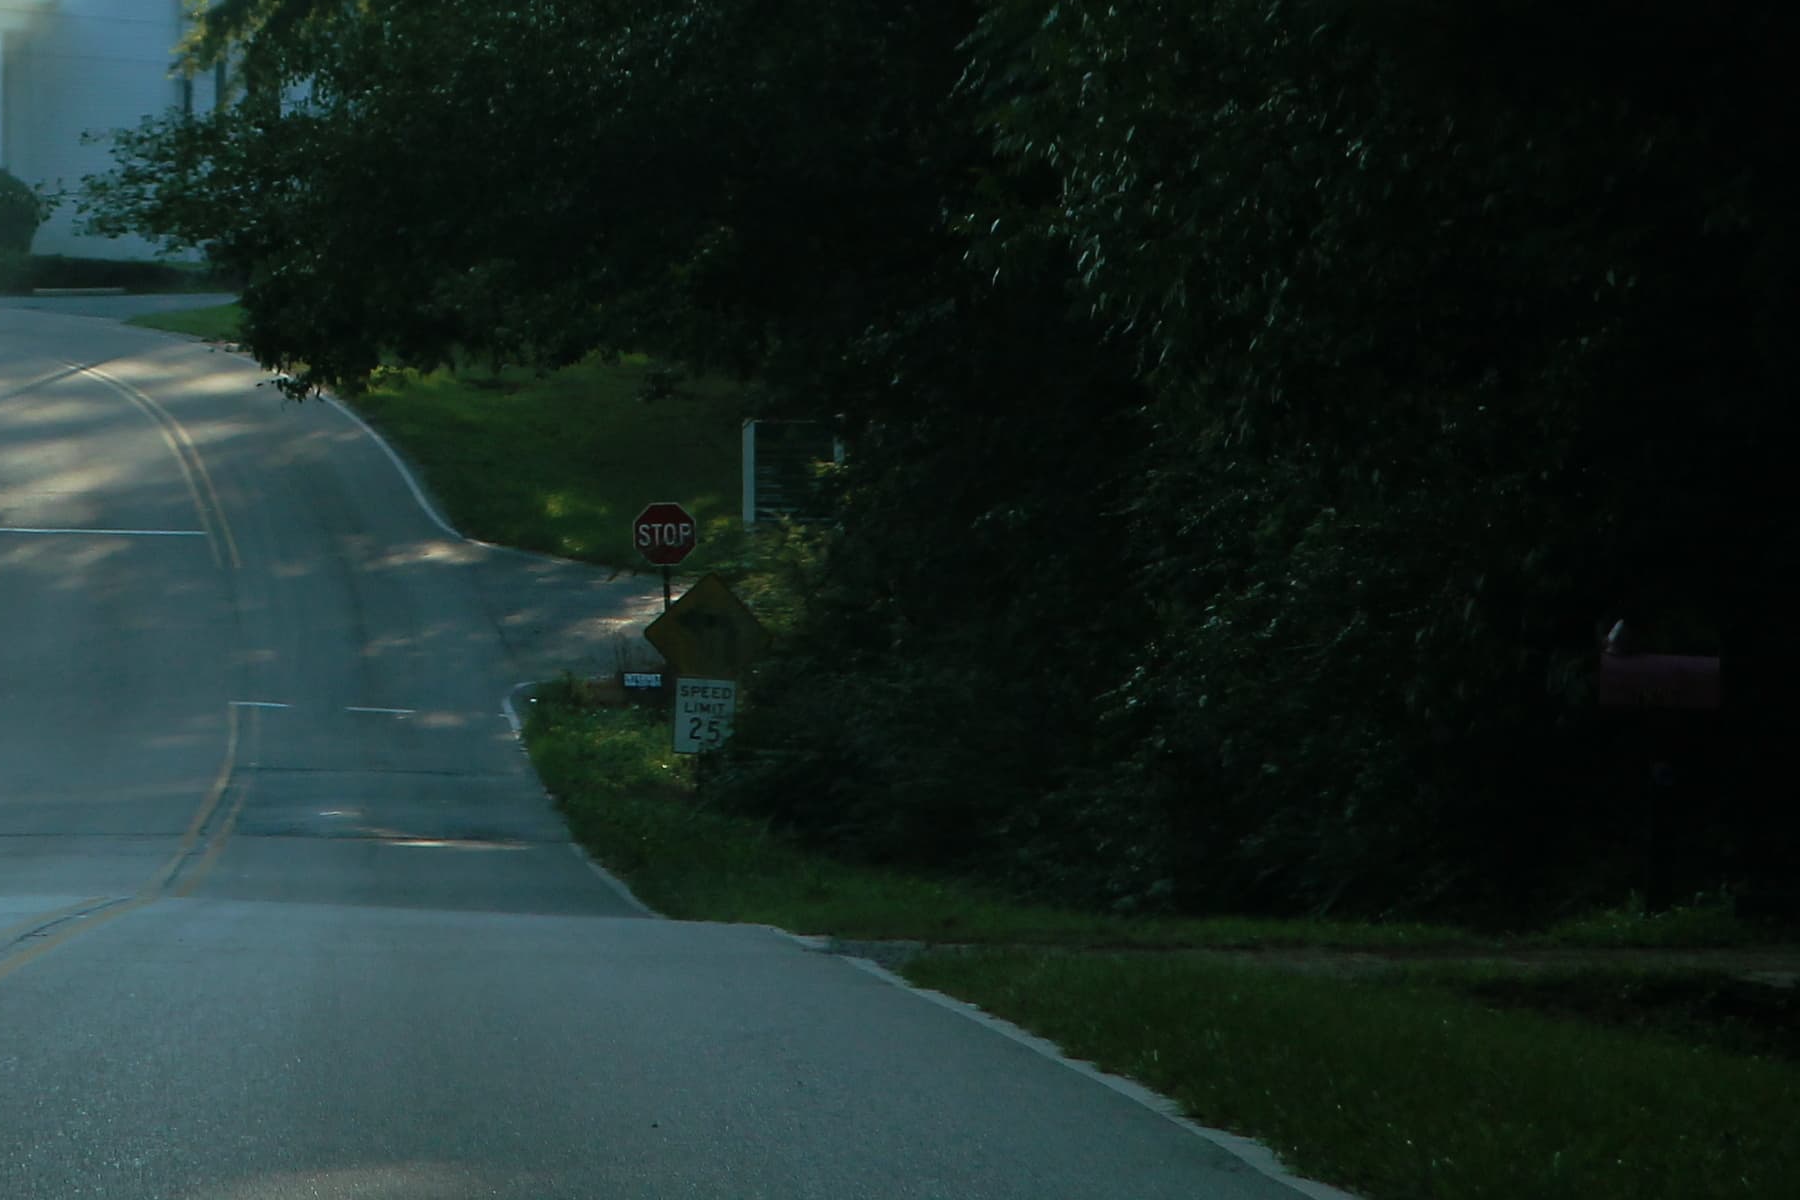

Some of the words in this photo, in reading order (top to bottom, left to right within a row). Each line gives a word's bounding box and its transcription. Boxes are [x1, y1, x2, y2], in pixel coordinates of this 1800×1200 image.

[639, 523, 691, 546] STOP
[680, 686, 732, 699] SPEED
[684, 702, 726, 714] LIMIT
[689, 717, 720, 743] 25
